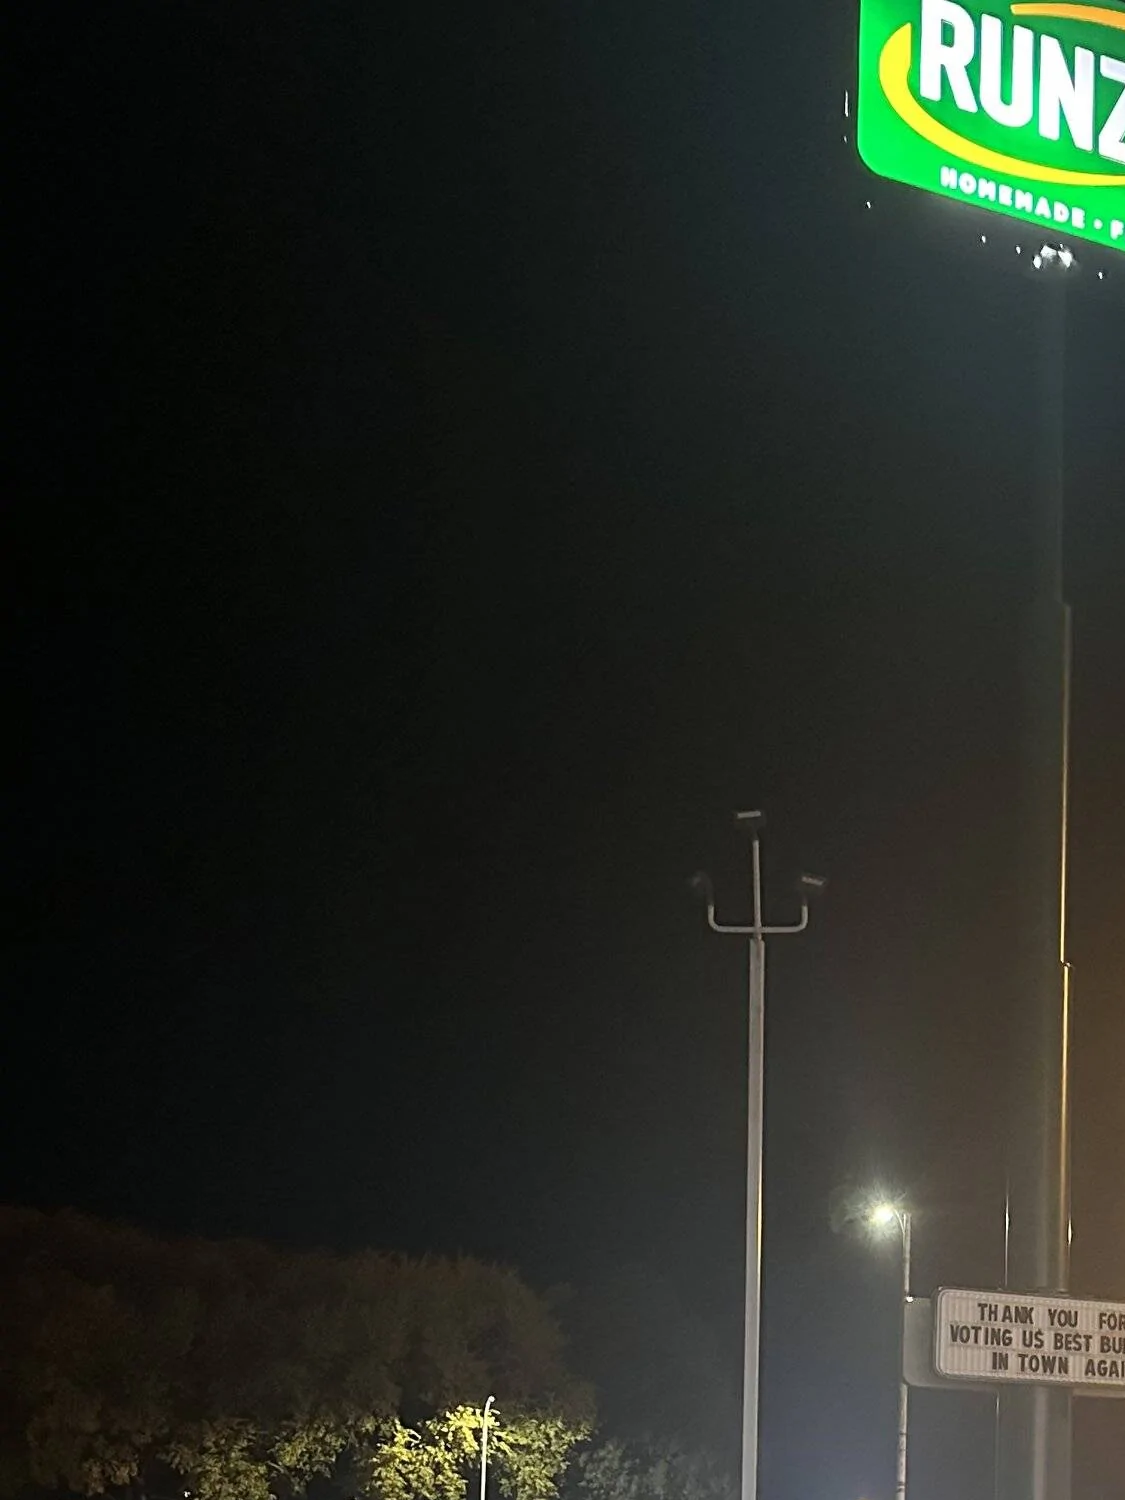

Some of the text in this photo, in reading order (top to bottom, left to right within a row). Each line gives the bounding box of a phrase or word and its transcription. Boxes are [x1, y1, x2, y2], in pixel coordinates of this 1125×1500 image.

[939, 166, 1086, 231] HOMEMADE
[977, 1302, 1034, 1325] THANK
[1048, 1308, 1079, 1328] YOU
[950, 1324, 1013, 1347] VOTING
[1022, 1329, 1045, 1349] US
[1053, 1332, 1092, 1353] BEST
[992, 1352, 1009, 1371] IN
[1018, 1354, 1069, 1375] TOWN
